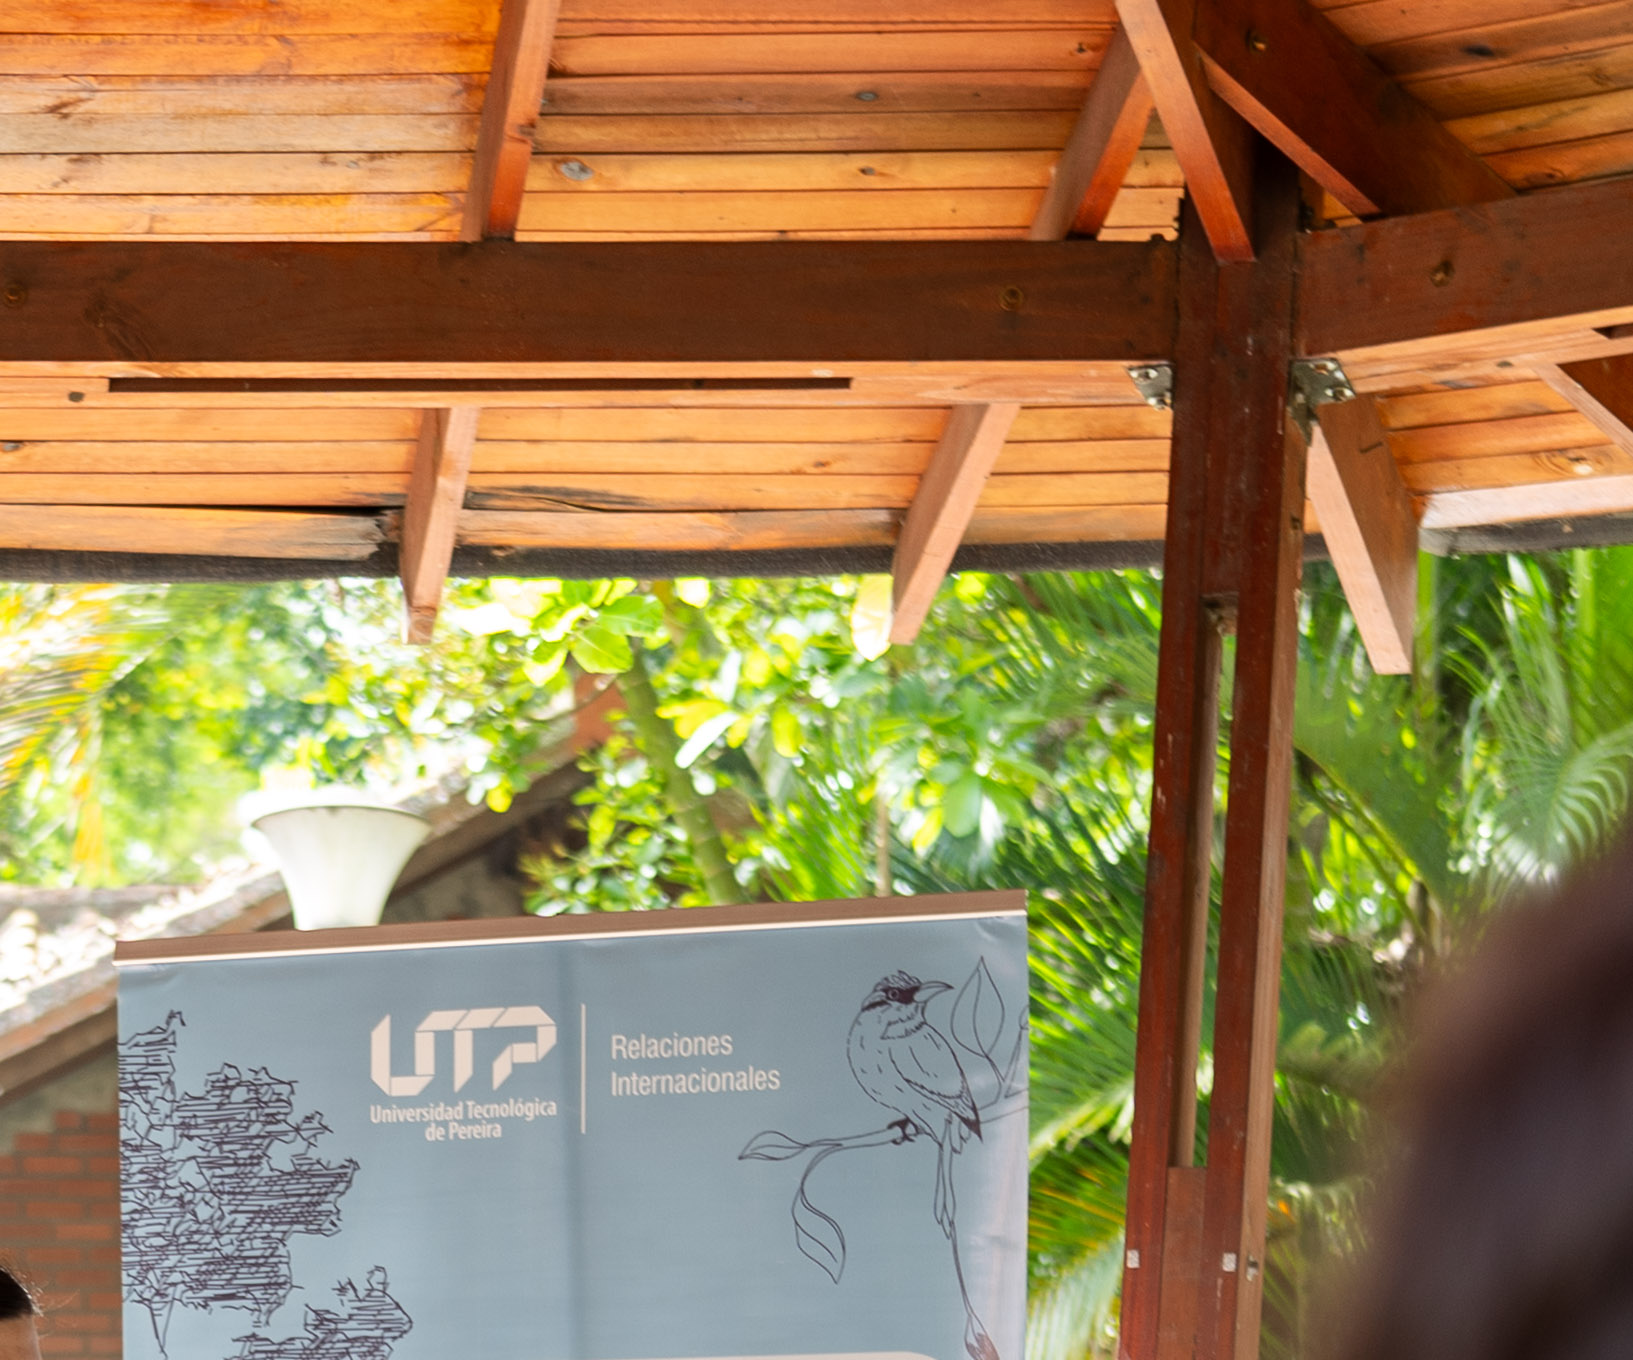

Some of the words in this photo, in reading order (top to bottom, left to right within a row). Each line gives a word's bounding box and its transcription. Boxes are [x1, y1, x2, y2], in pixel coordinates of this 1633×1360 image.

[371, 1005, 557, 1097] UTP
[611, 1032, 733, 1061] Relaciones
[611, 1065, 781, 1097] Internacionales
[370, 1101, 464, 1124] Universidad
[467, 1099, 557, 1122] Tecnológica
[426, 1123, 445, 1141] de
[449, 1121, 502, 1140] Pereira
